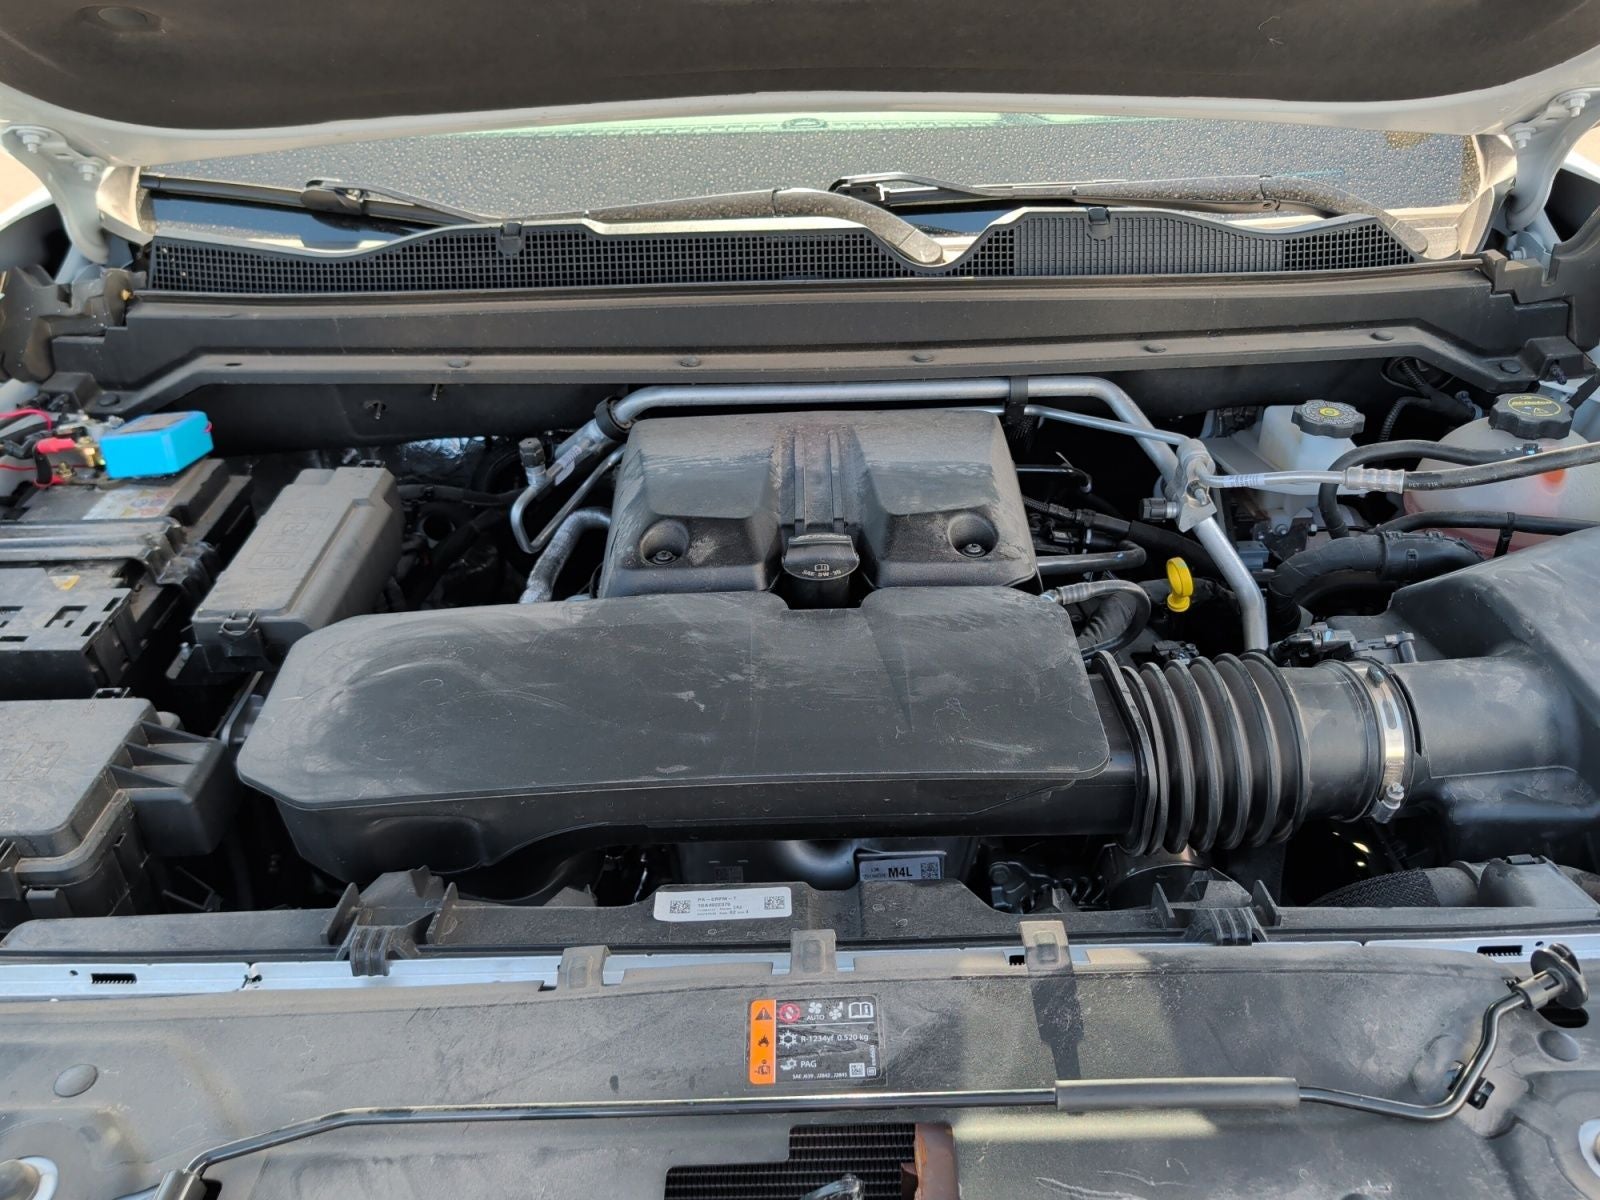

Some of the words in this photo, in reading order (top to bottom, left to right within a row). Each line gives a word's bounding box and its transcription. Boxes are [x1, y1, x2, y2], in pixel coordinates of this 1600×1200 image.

[888, 866, 913, 878] M4L
[800, 1035, 834, 1043] R-1234yf
[859, 1034, 868, 1042] kg
[800, 1059, 817, 1068] PAG
